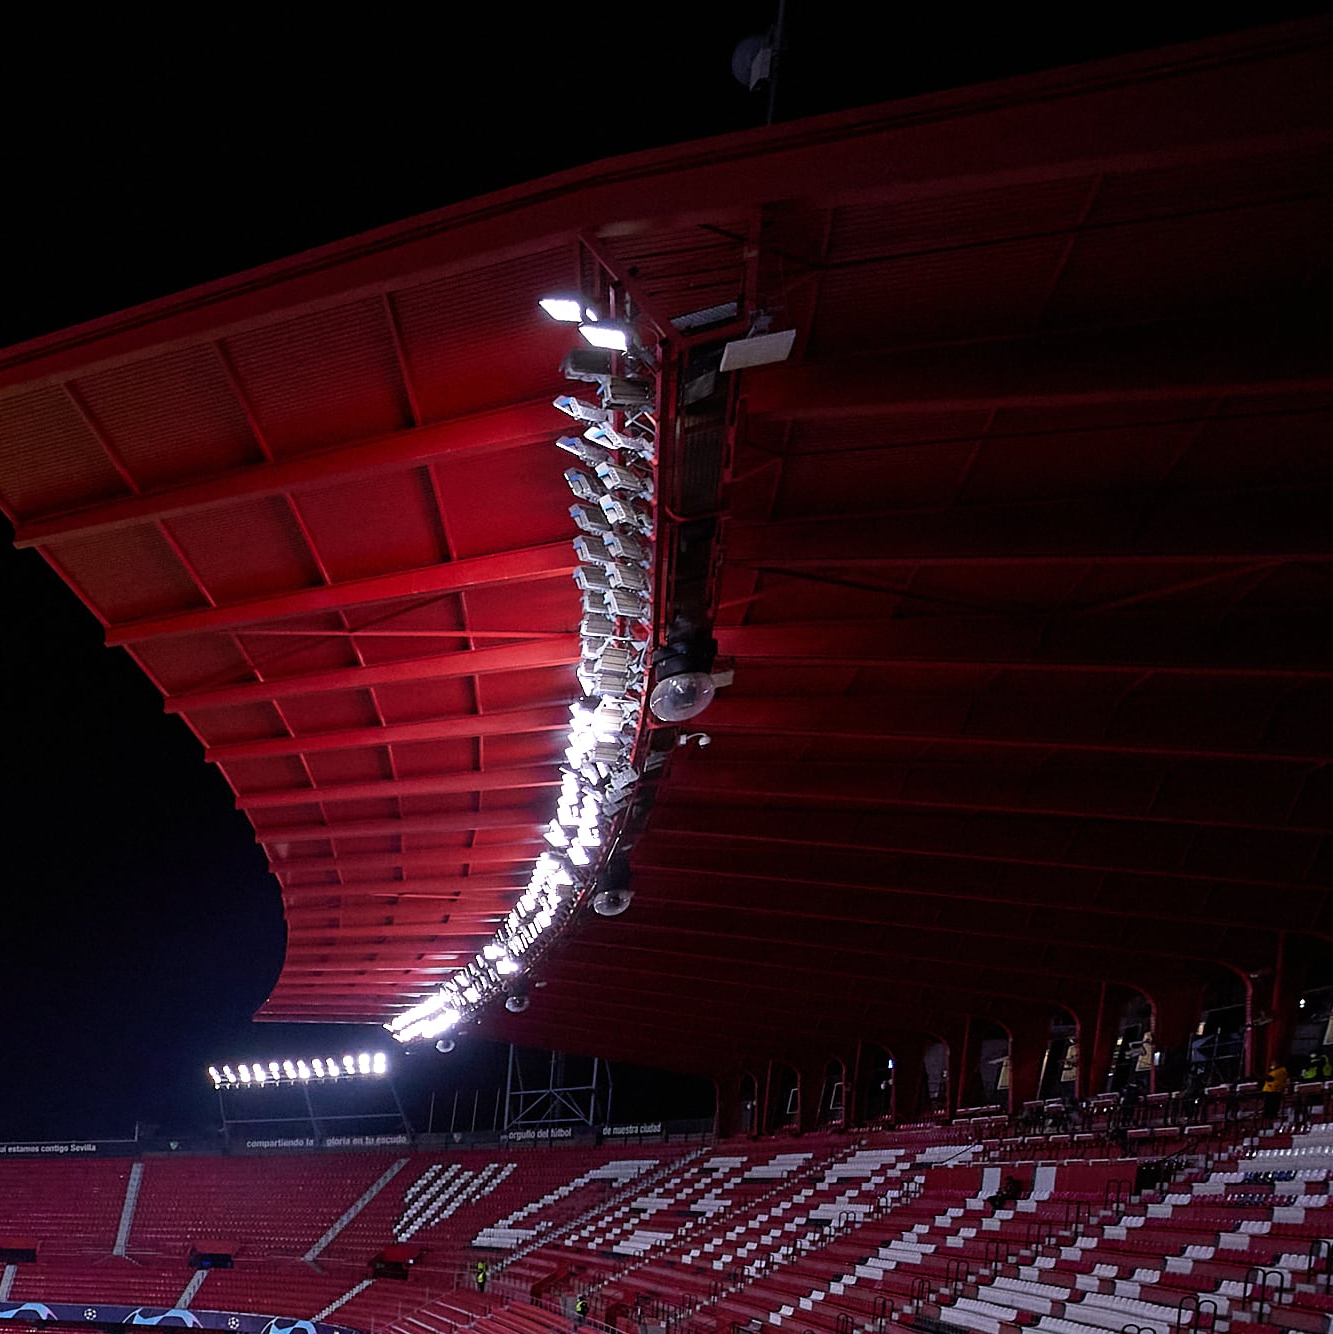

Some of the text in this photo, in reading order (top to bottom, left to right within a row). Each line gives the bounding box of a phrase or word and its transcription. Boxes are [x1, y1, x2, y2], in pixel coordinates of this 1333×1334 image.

[508, 1123, 661, 1141] orgullo del fútbol de nuestra ciudad
[246, 1135, 406, 1148] compartiendo la gloria en tu escudo
[7, 1145, 39, 1153] estamos
[40, 1144, 69, 1154] contigo
[70, 1143, 97, 1152] Sevilla
